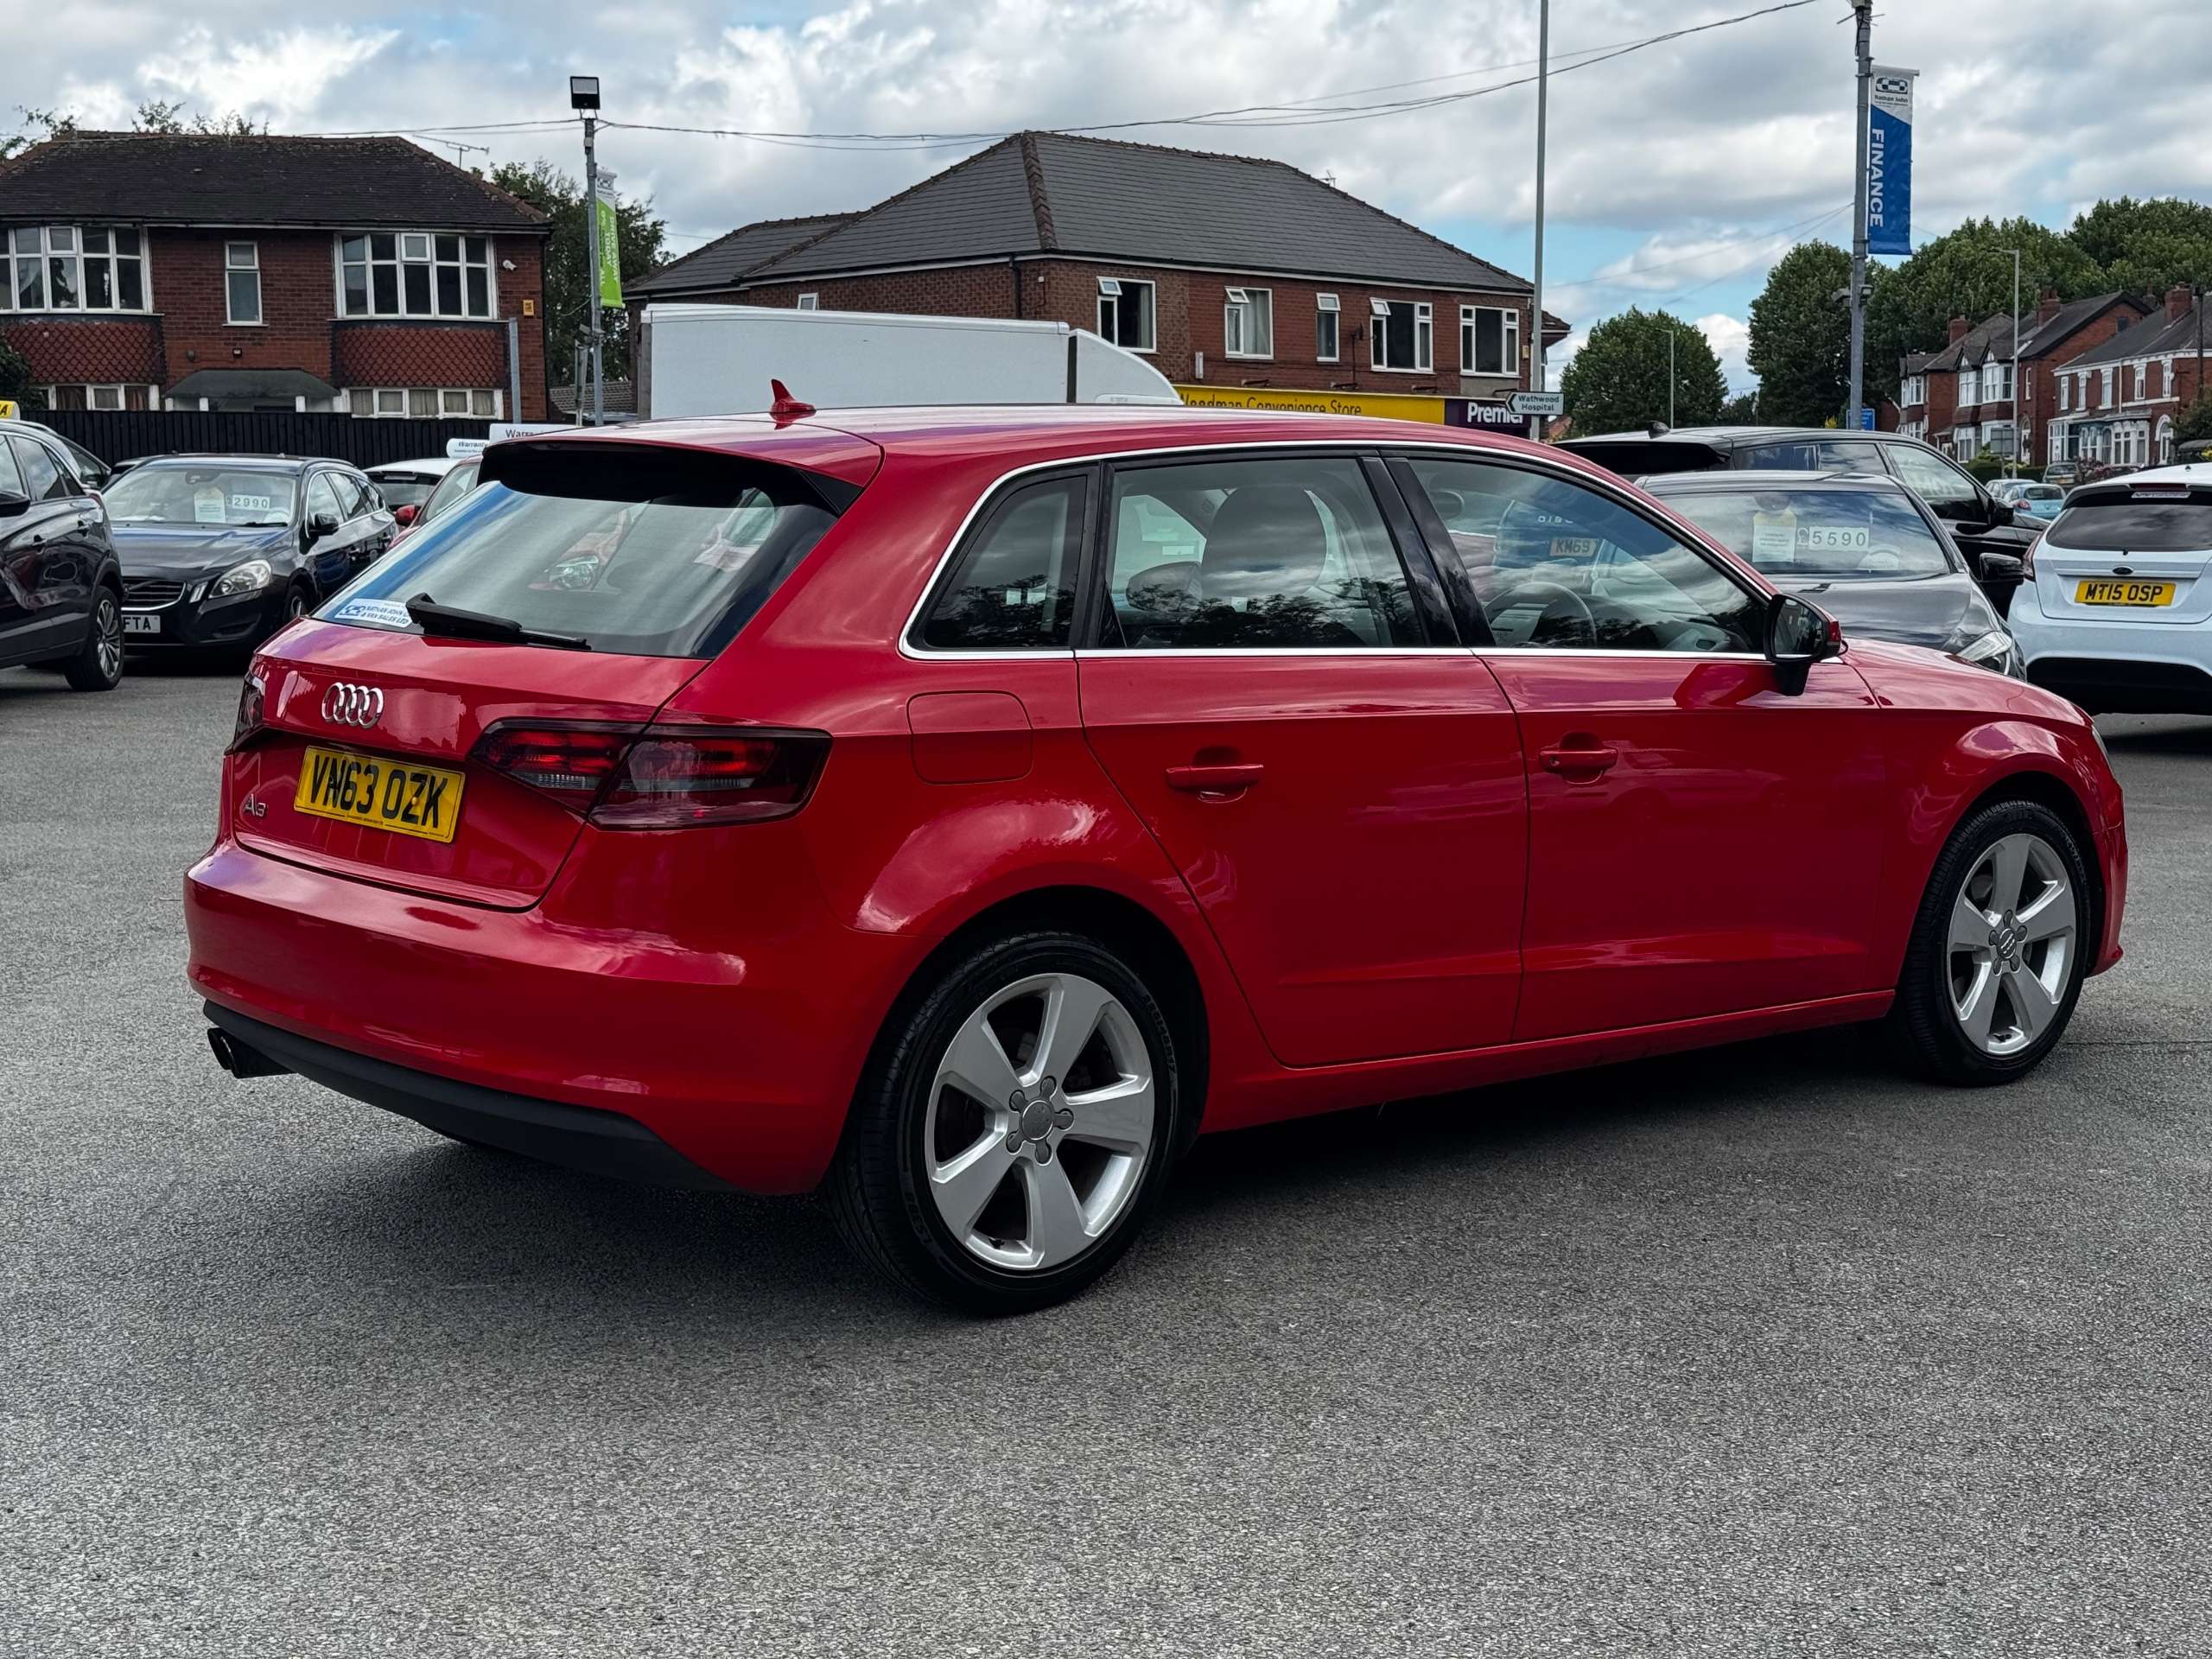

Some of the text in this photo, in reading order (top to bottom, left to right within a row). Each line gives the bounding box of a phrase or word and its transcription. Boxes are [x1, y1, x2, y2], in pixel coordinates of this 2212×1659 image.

[1870, 129, 1885, 227] FINANCE
[1331, 400, 1363, 416] Store
[1518, 394, 1560, 404] Wathwood
[1522, 404, 1555, 412] Hospital
[2085, 584, 2163, 602] MT15 OSP
[311, 754, 448, 829] VN63 OZK
[244, 794, 267, 817] A3
